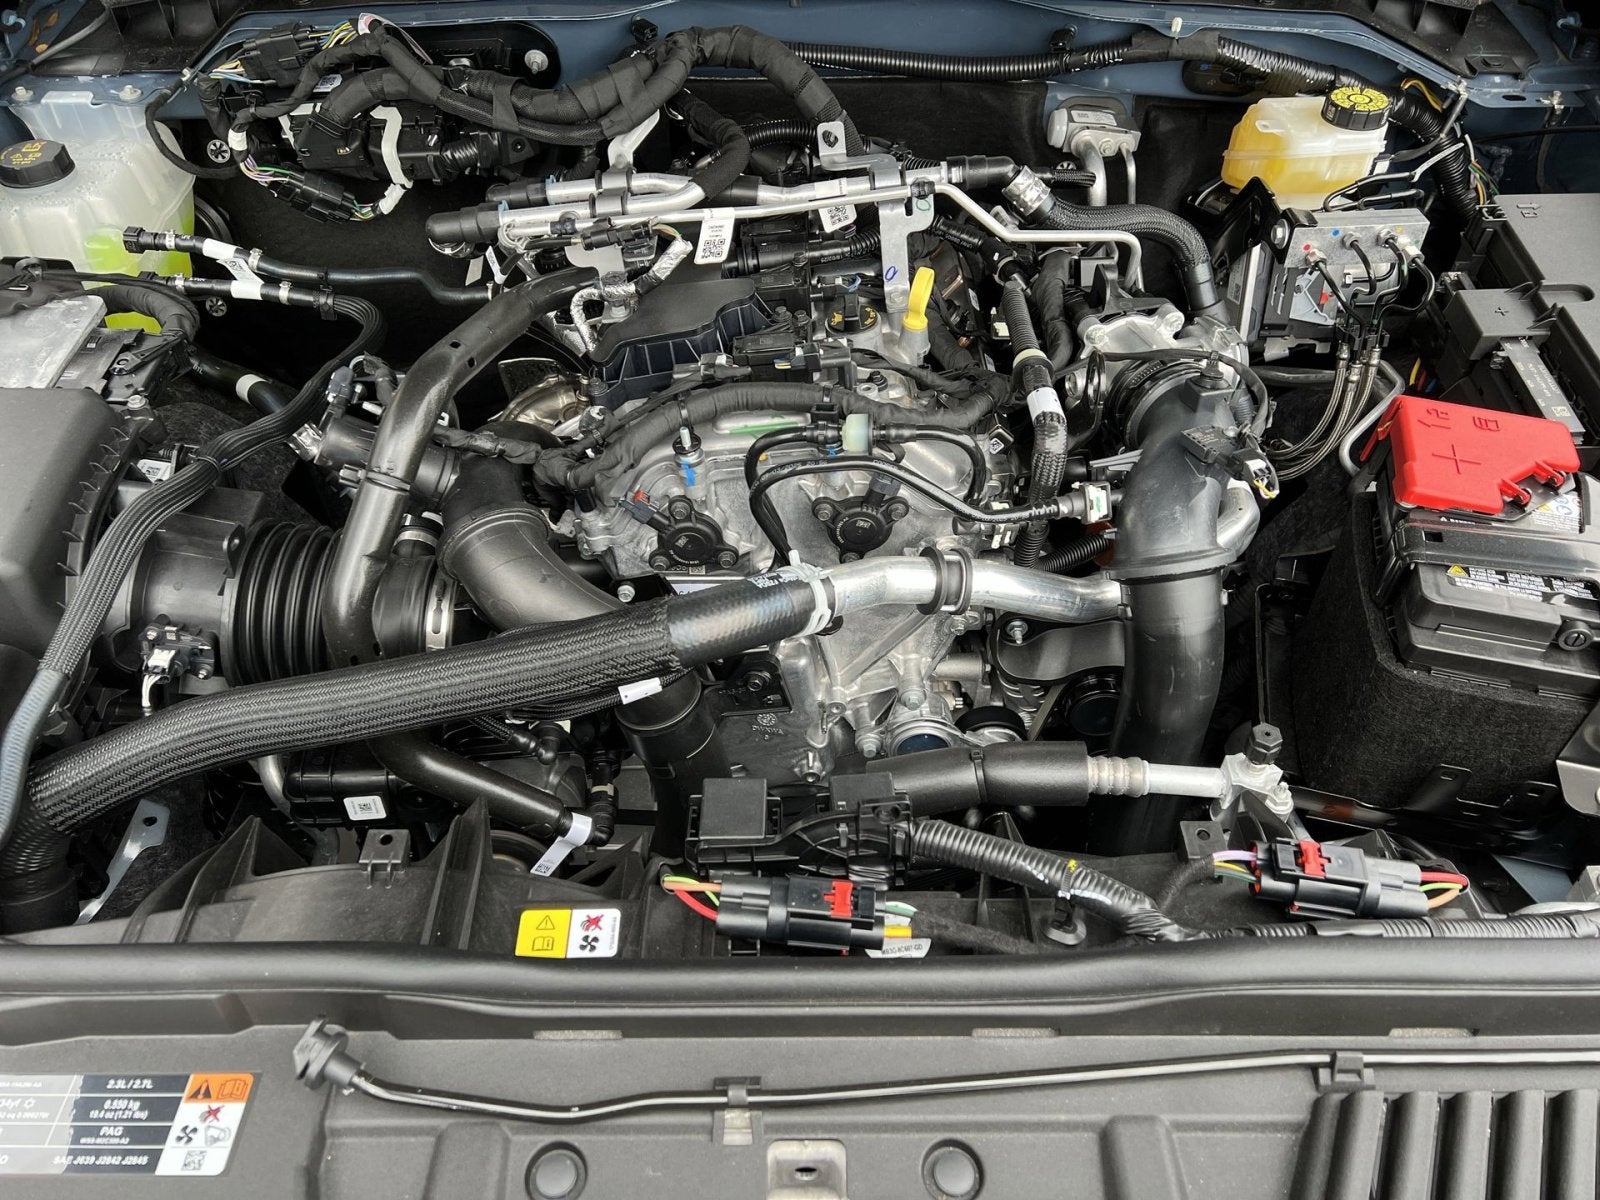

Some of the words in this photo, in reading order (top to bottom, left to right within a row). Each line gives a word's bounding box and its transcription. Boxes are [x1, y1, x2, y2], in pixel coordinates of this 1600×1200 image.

[106, 1079, 126, 1089] 2.3L
[132, 1079, 154, 1089] 2.7L
[128, 1099, 141, 1112] kg
[100, 1126, 124, 1136] PAG
[53, 1155, 74, 1165] SAE
